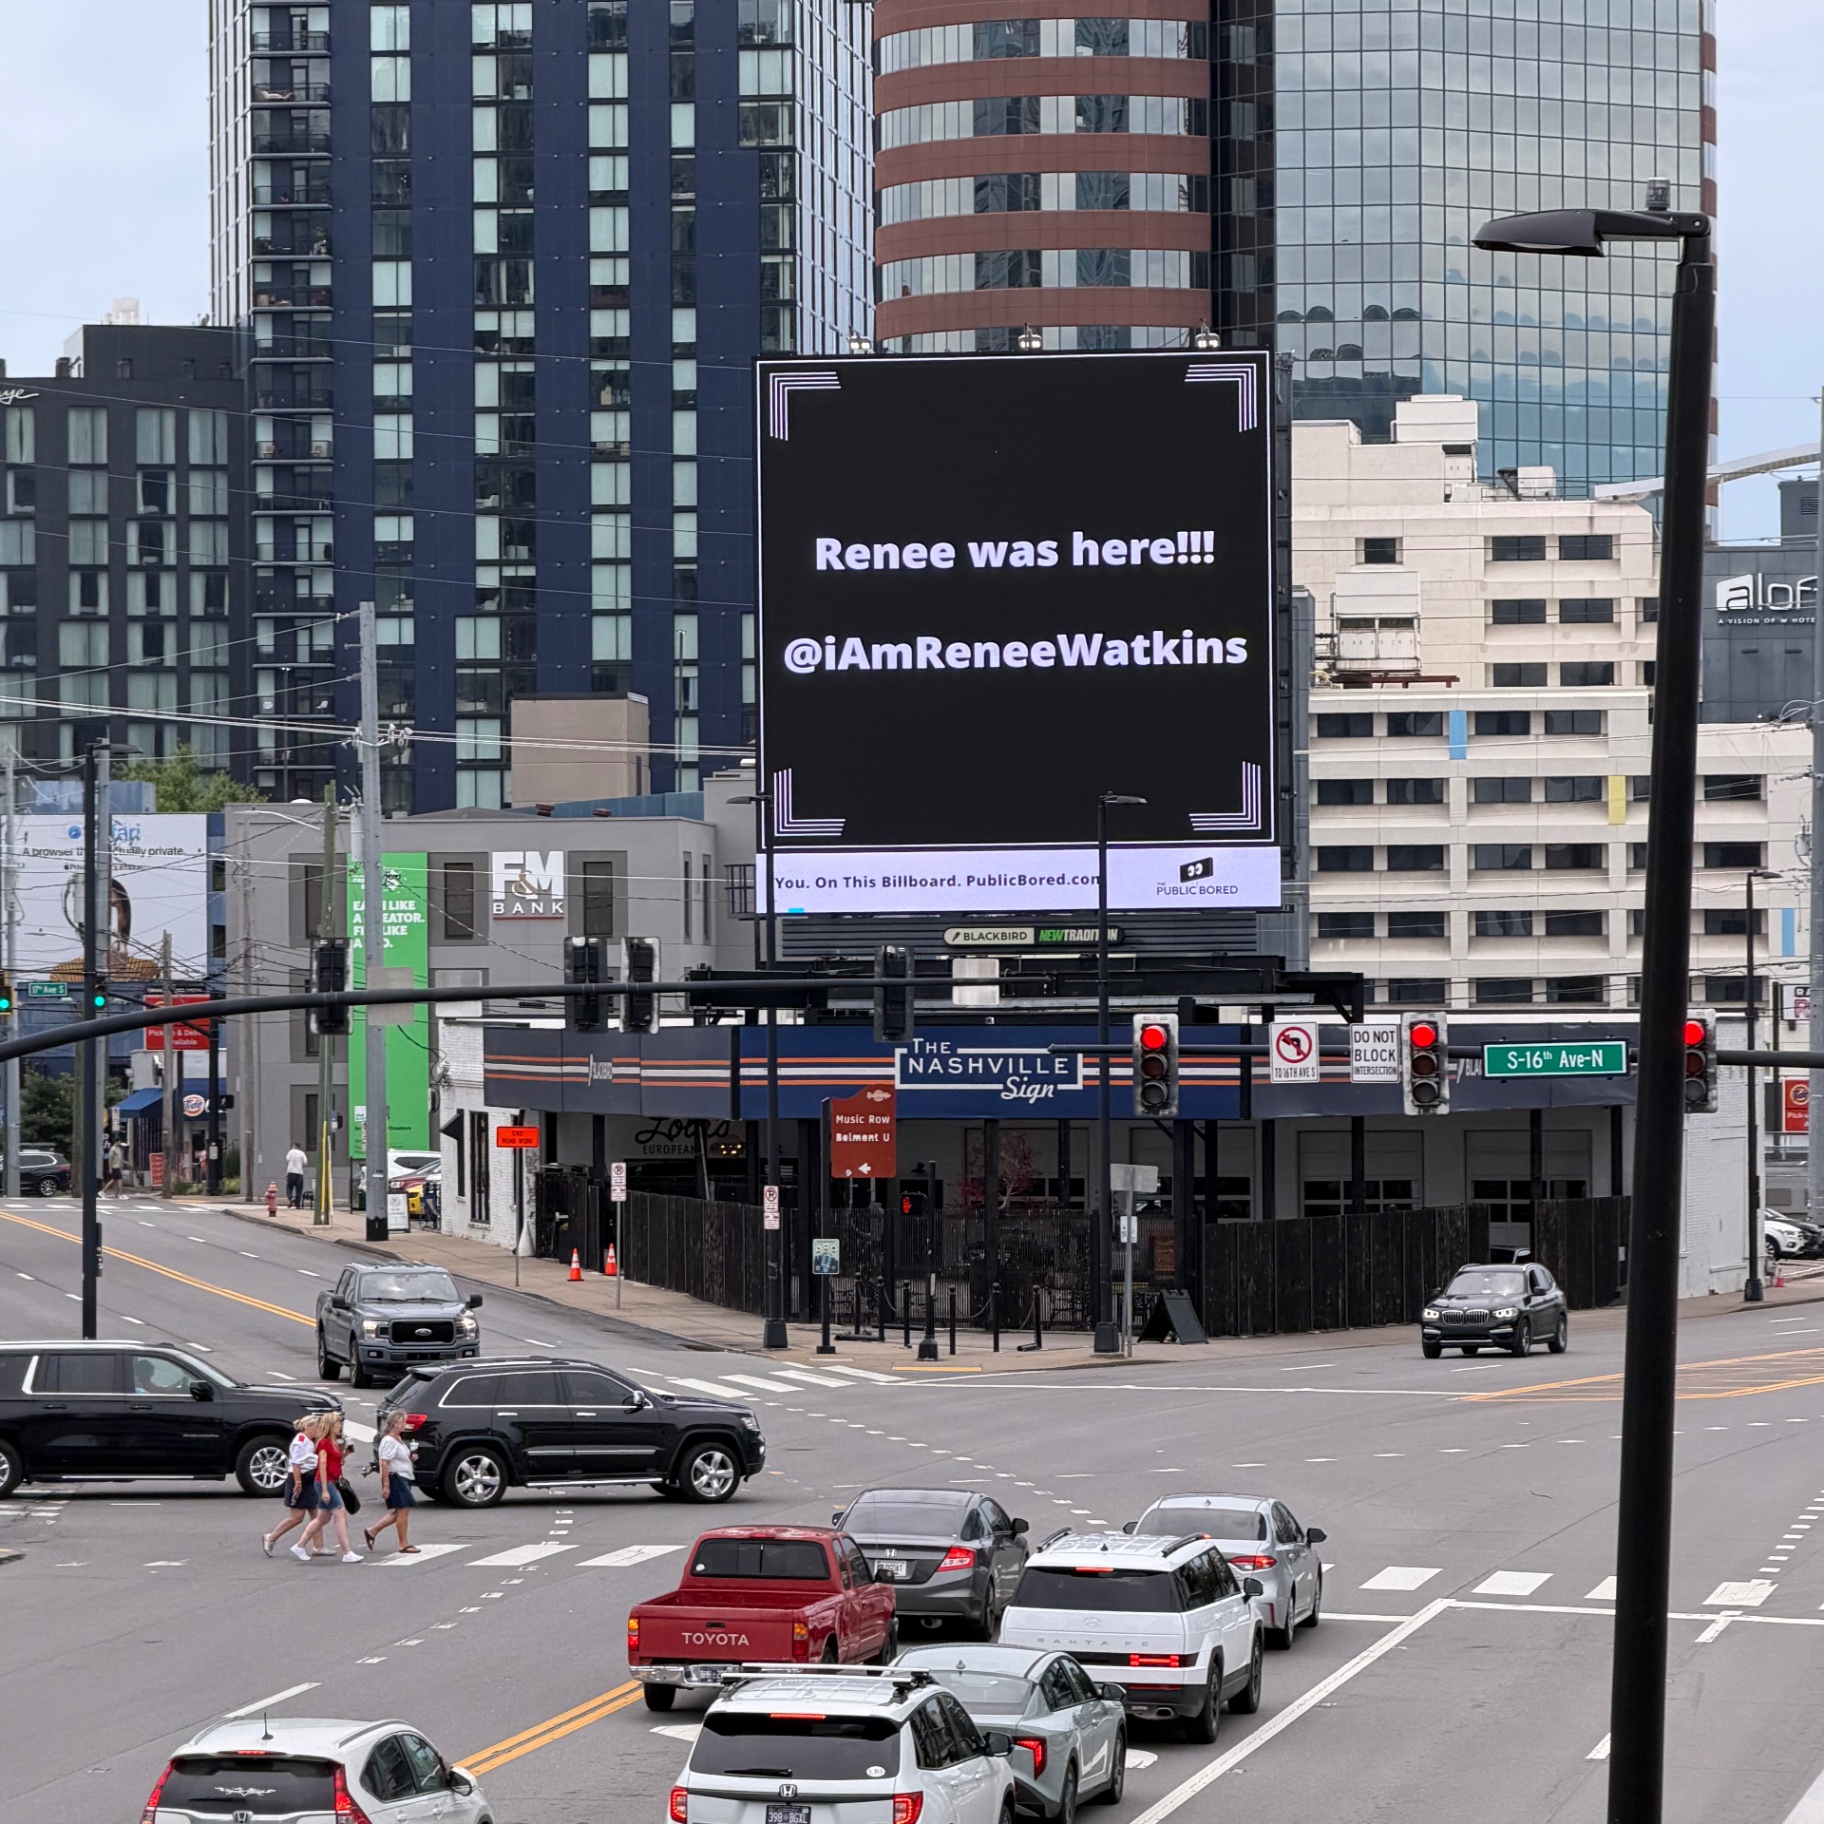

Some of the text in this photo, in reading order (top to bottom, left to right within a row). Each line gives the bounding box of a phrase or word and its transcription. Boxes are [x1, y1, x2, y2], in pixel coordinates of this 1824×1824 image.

[816, 531, 1215, 571] Renee was here!!!
[1716, 572, 1819, 611] alof
[784, 629, 1248, 674] @iAmReneeWatkins
[492, 851, 564, 900] F&M
[775, 877, 810, 889] You.
[815, 877, 838, 889] On
[843, 876, 876, 888] This
[882, 875, 961, 888] Billboard.
[1157, 885, 1239, 896] PUBLIC BORED
[388, 900, 416, 910] LIKE
[492, 902, 564, 914] BANK
[382, 913, 426, 924] EATOR.
[963, 931, 1028, 941] BLACKBIRD
[43, 985, 57, 994] Ave
[59, 984, 64, 994] S
[1354, 1030, 1396, 1043] DO NOT
[1354, 1049, 1396, 1062] BLOCK
[1507, 1049, 1604, 1069] S-16th Ave-N
[908, 1057, 1069, 1075] NASHVILLE
[1353, 1066, 1397, 1076] INTERSECTION
[1275, 1068, 1282, 1078] TO
[1299, 1067, 1310, 1078] AVE
[1001, 1076, 1054, 1104] Sign
[835, 1114, 891, 1124] Music Row
[835, 1132, 890, 1142] Belmont U
[681, 1632, 750, 1646] TOYOTA
[1037, 1637, 1110, 1646] SANTA
